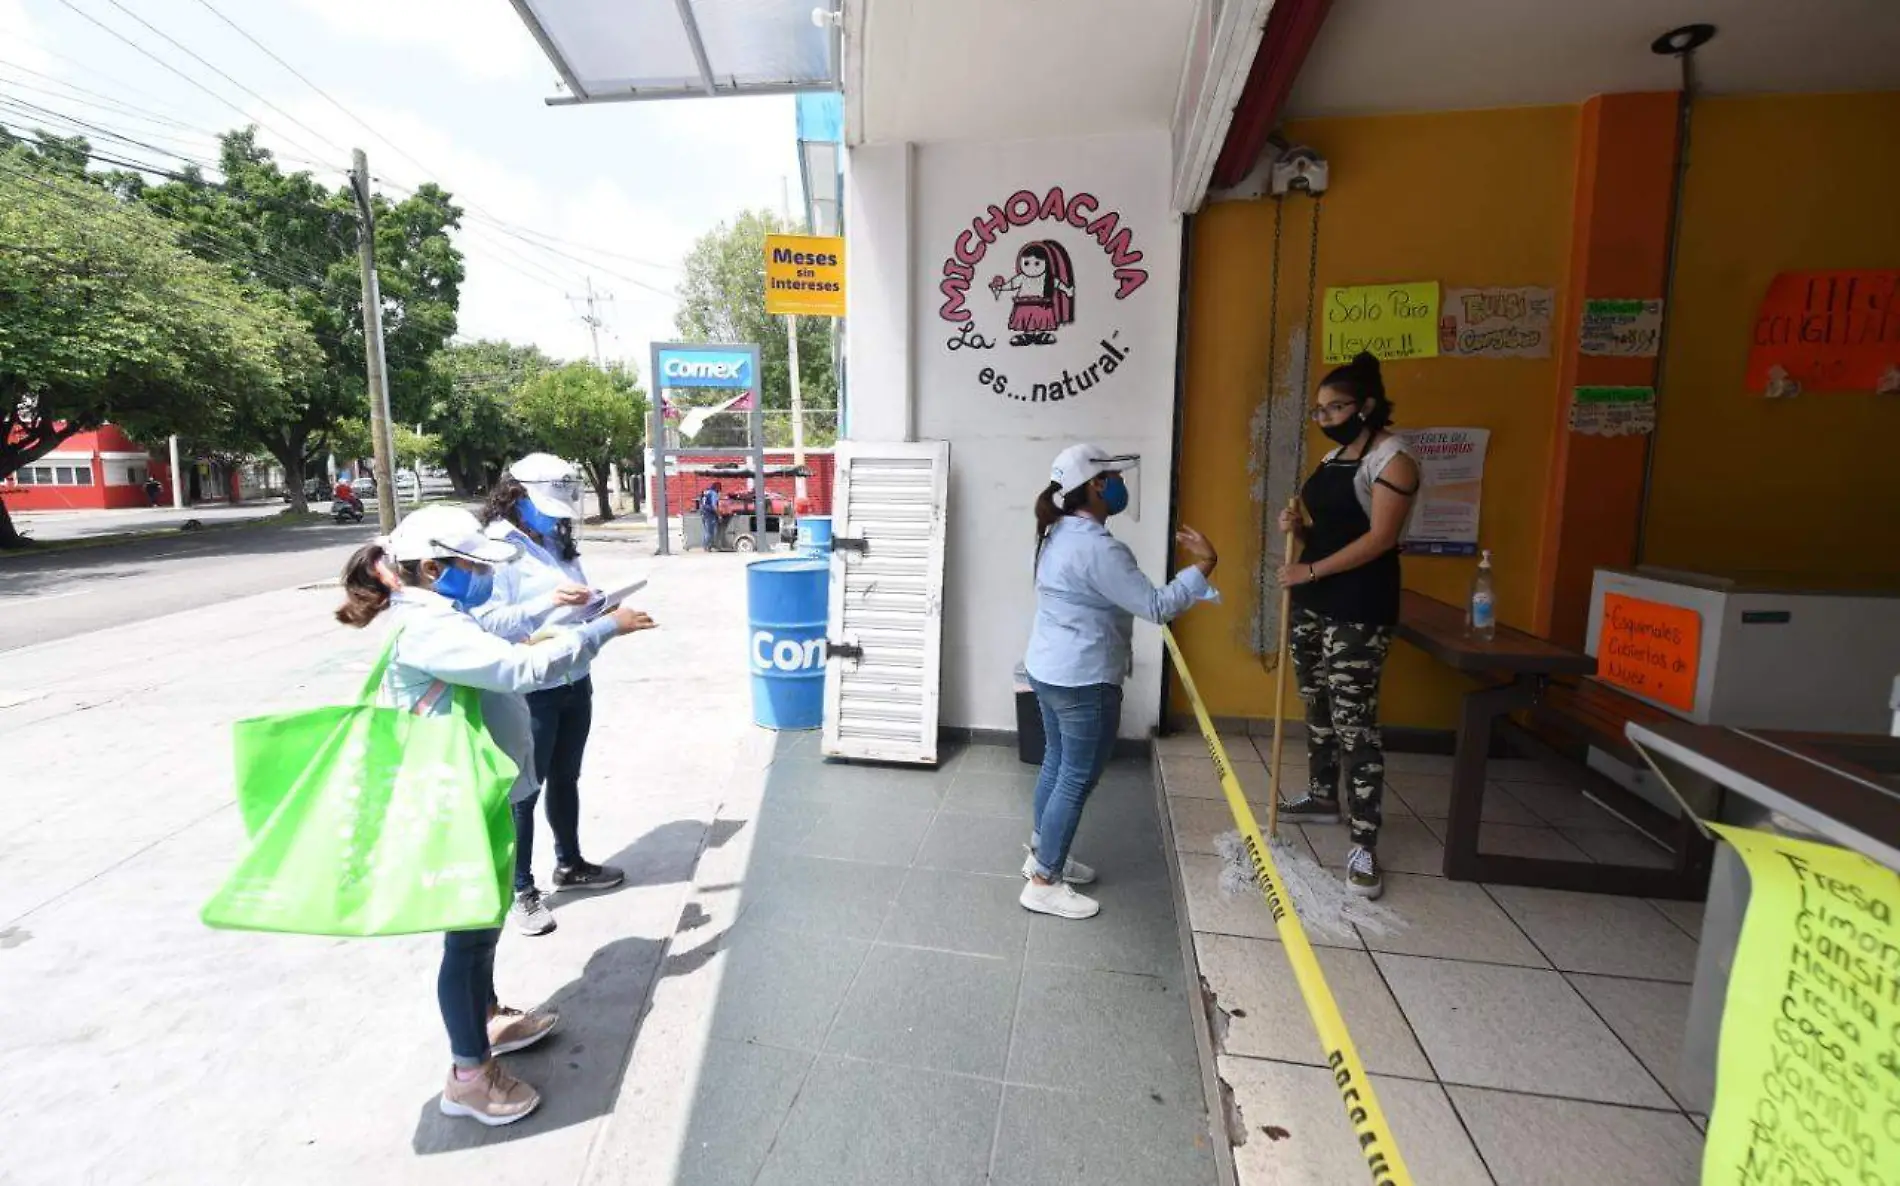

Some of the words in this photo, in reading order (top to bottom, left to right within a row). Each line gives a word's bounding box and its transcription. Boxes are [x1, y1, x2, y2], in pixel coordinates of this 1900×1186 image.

[773, 248, 837, 266] Meses
[939, 187, 1148, 322] MICHOACANA
[797, 269, 814, 277] sin
[1330, 290, 1382, 323] Solo
[947, 322, 996, 350] La
[664, 358, 745, 379] Comex
[1774, 849, 1891, 926] Fresa
[1782, 995, 1845, 1061] Coco
